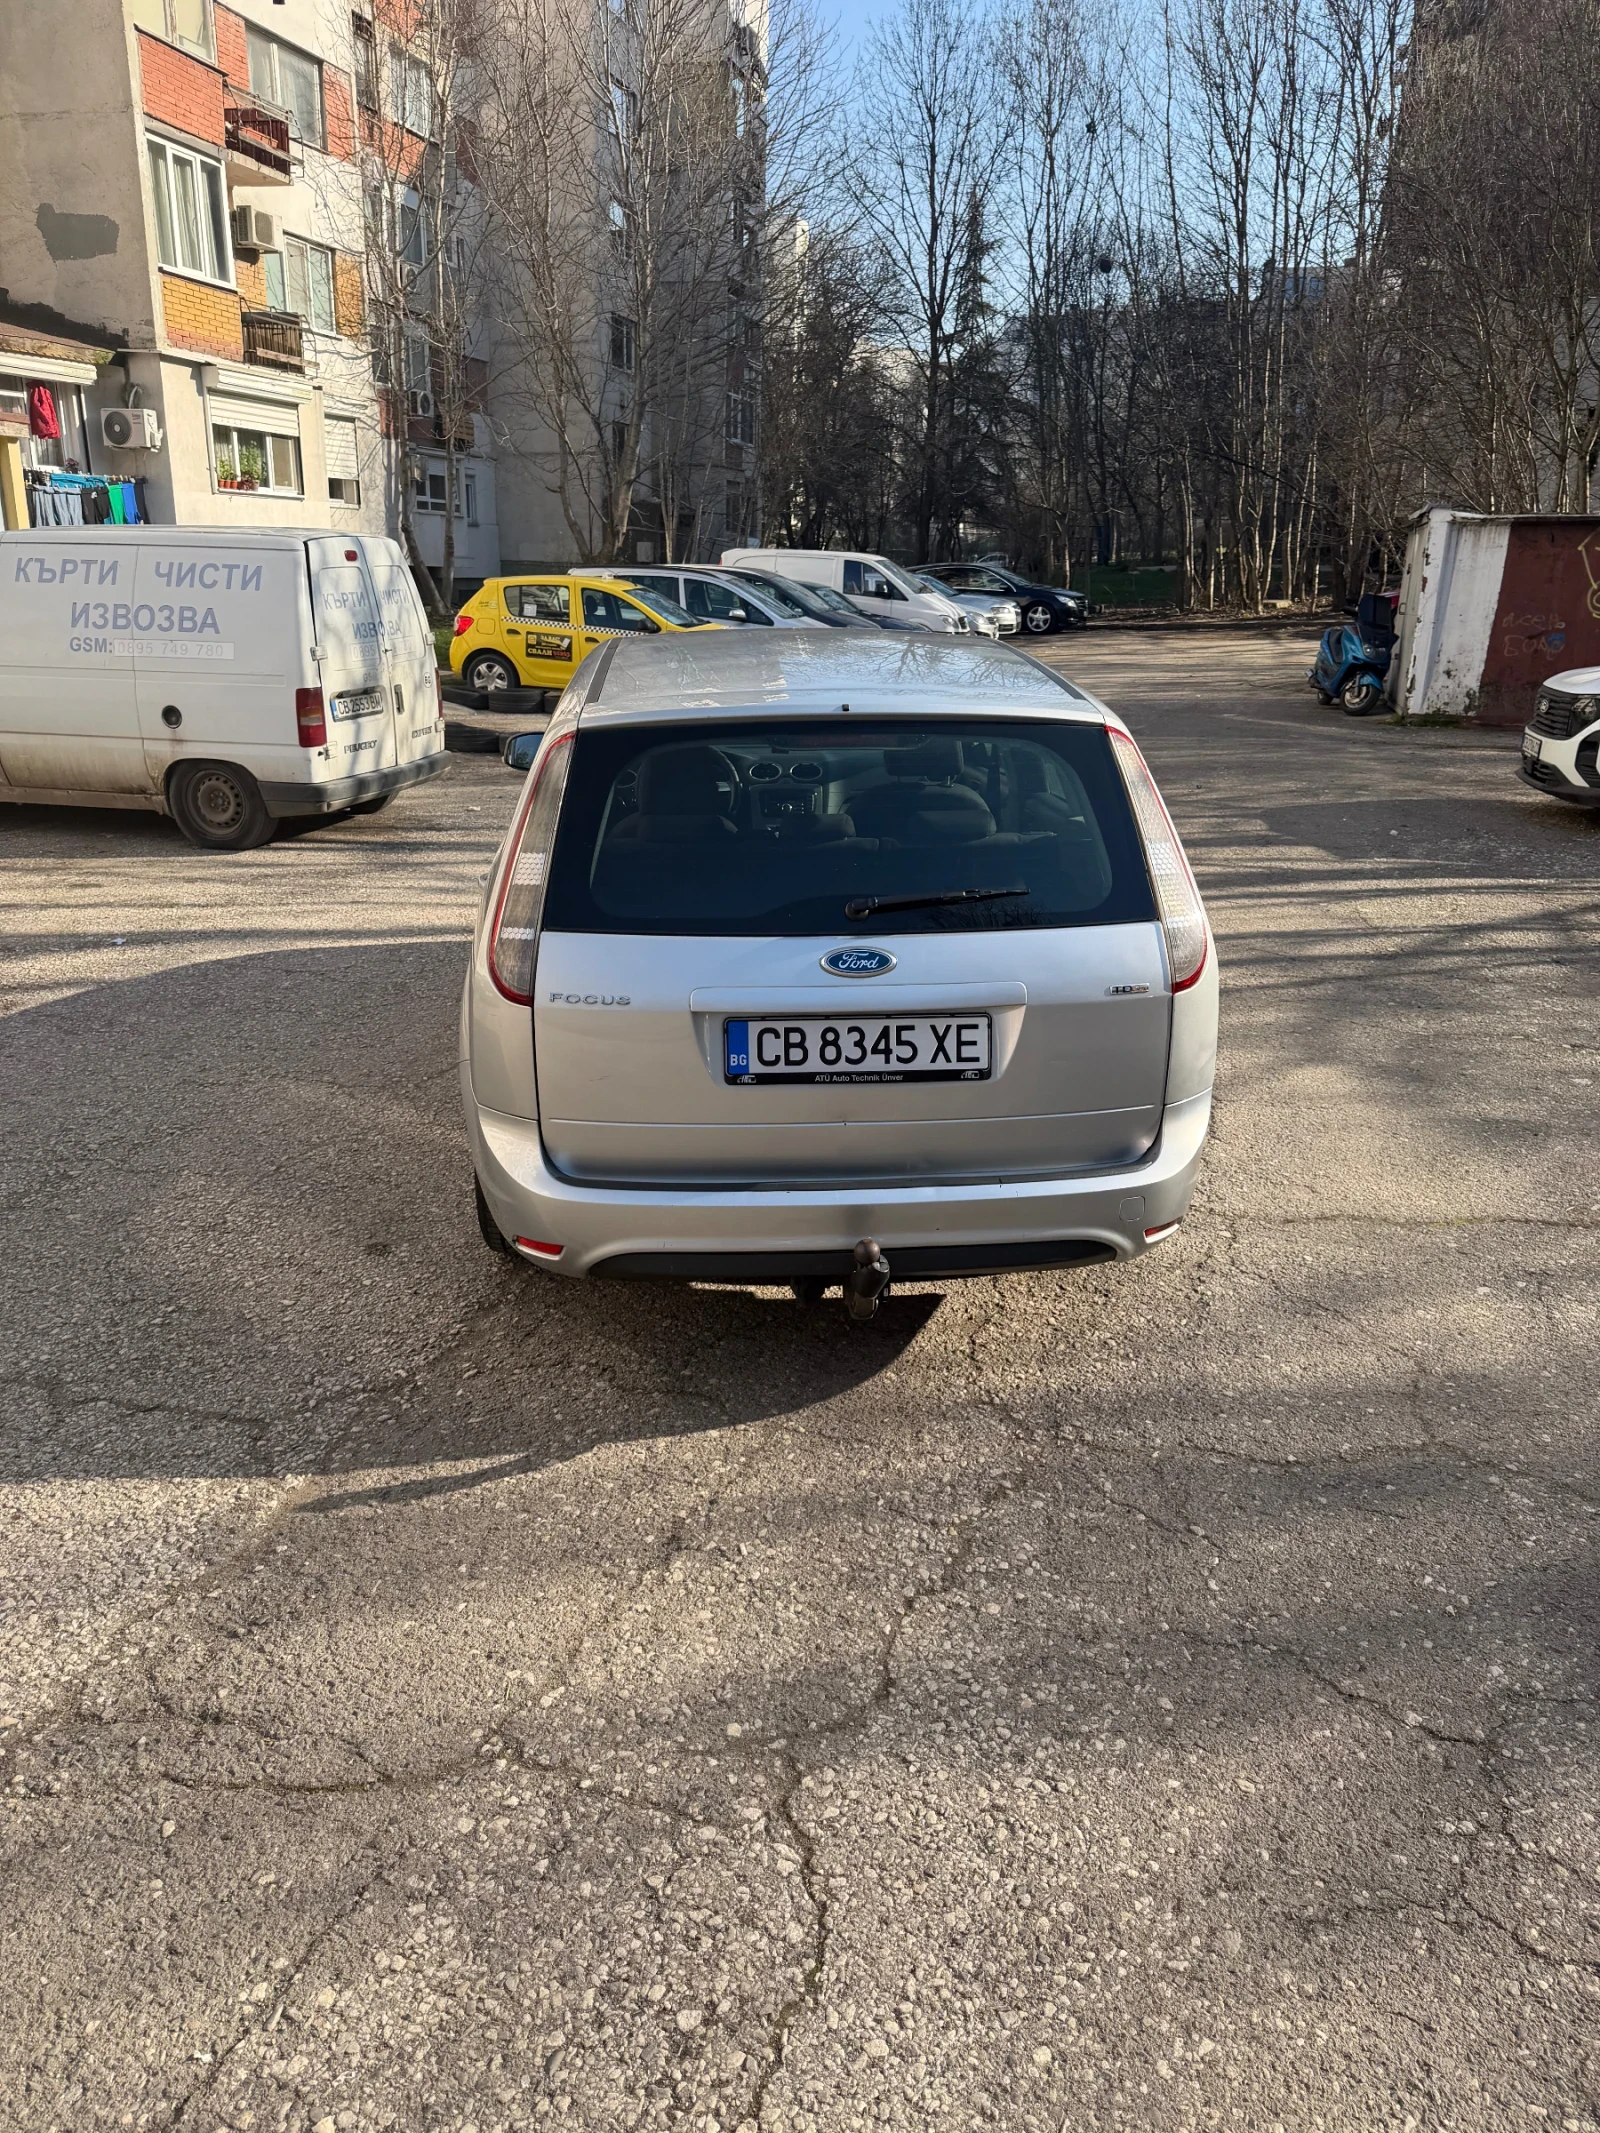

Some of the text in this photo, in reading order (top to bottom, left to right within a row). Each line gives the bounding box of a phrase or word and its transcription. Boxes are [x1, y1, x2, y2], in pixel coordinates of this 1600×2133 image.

[15, 557, 263, 592] КЪРТИ ЧИСТИ
[322, 588, 410, 611] КЪРТИ ЧИСТИ
[70, 602, 221, 635] ИЗВОЗВА
[352, 620, 402, 640] ИЗВОВА
[69, 636, 224, 657] GSM: 0895 749 780
[350, 697, 370, 713] 2553
[838, 952, 880, 969] Ford
[549, 992, 631, 1006] FOCUS
[756, 1023, 981, 1067] CB 8345 XE
[730, 1054, 747, 1066] BG
[814, 1073, 904, 1083] ATÜ Auto Technik Ünver
